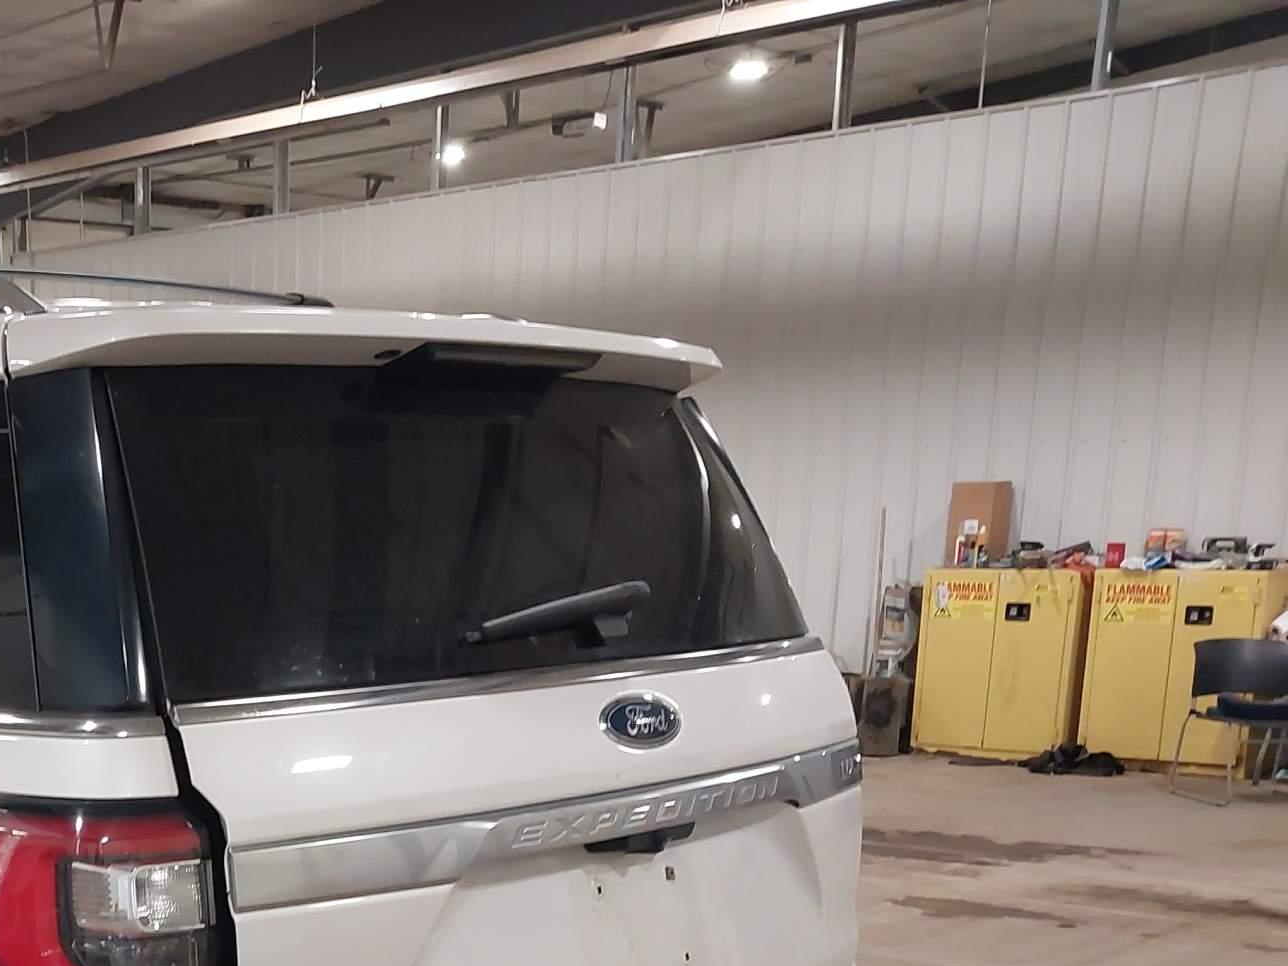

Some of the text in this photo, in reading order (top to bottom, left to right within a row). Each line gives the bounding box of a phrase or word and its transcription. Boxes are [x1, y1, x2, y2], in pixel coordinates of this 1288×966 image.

[1107, 584, 1172, 595] FLAMMABLE
[624, 704, 670, 737] Ford
[511, 774, 780, 849] EXPEDITION
